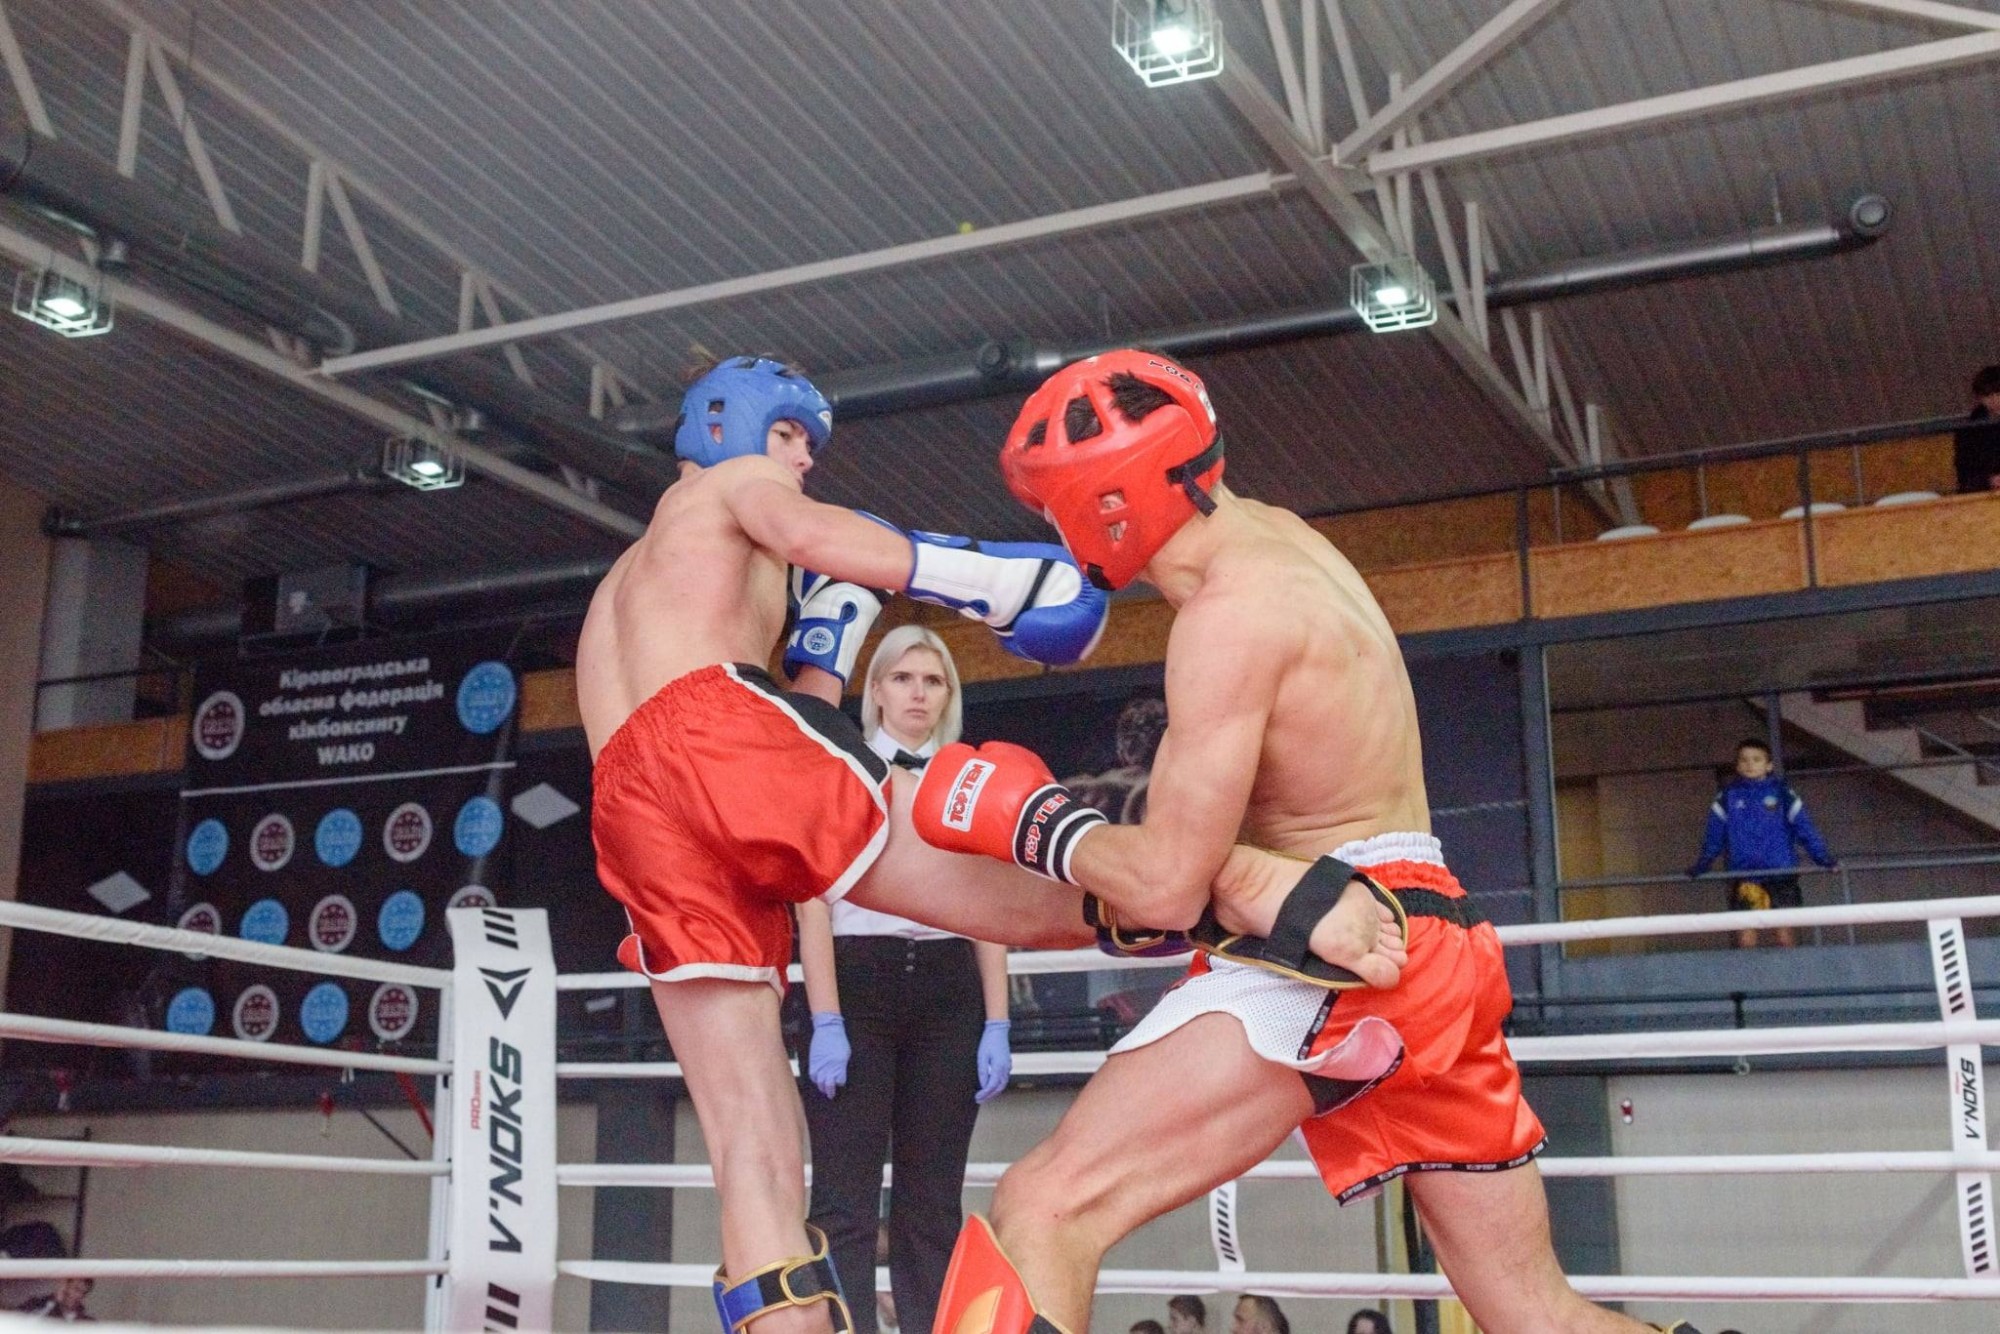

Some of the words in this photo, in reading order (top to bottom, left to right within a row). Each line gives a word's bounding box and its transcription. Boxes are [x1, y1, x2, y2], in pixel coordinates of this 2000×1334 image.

[340, 679, 444, 711] федерація
[289, 716, 408, 740] кікбоксингу
[318, 742, 375, 765] WAKO
[950, 791, 968, 822] TOP
[960, 763, 986, 790] TEN
[1025, 824, 1041, 864] TOP
[1033, 793, 1071, 824] TEN
[1961, 1057, 1981, 1139] V'NOKS
[489, 1036, 523, 1254] V'NOKS
